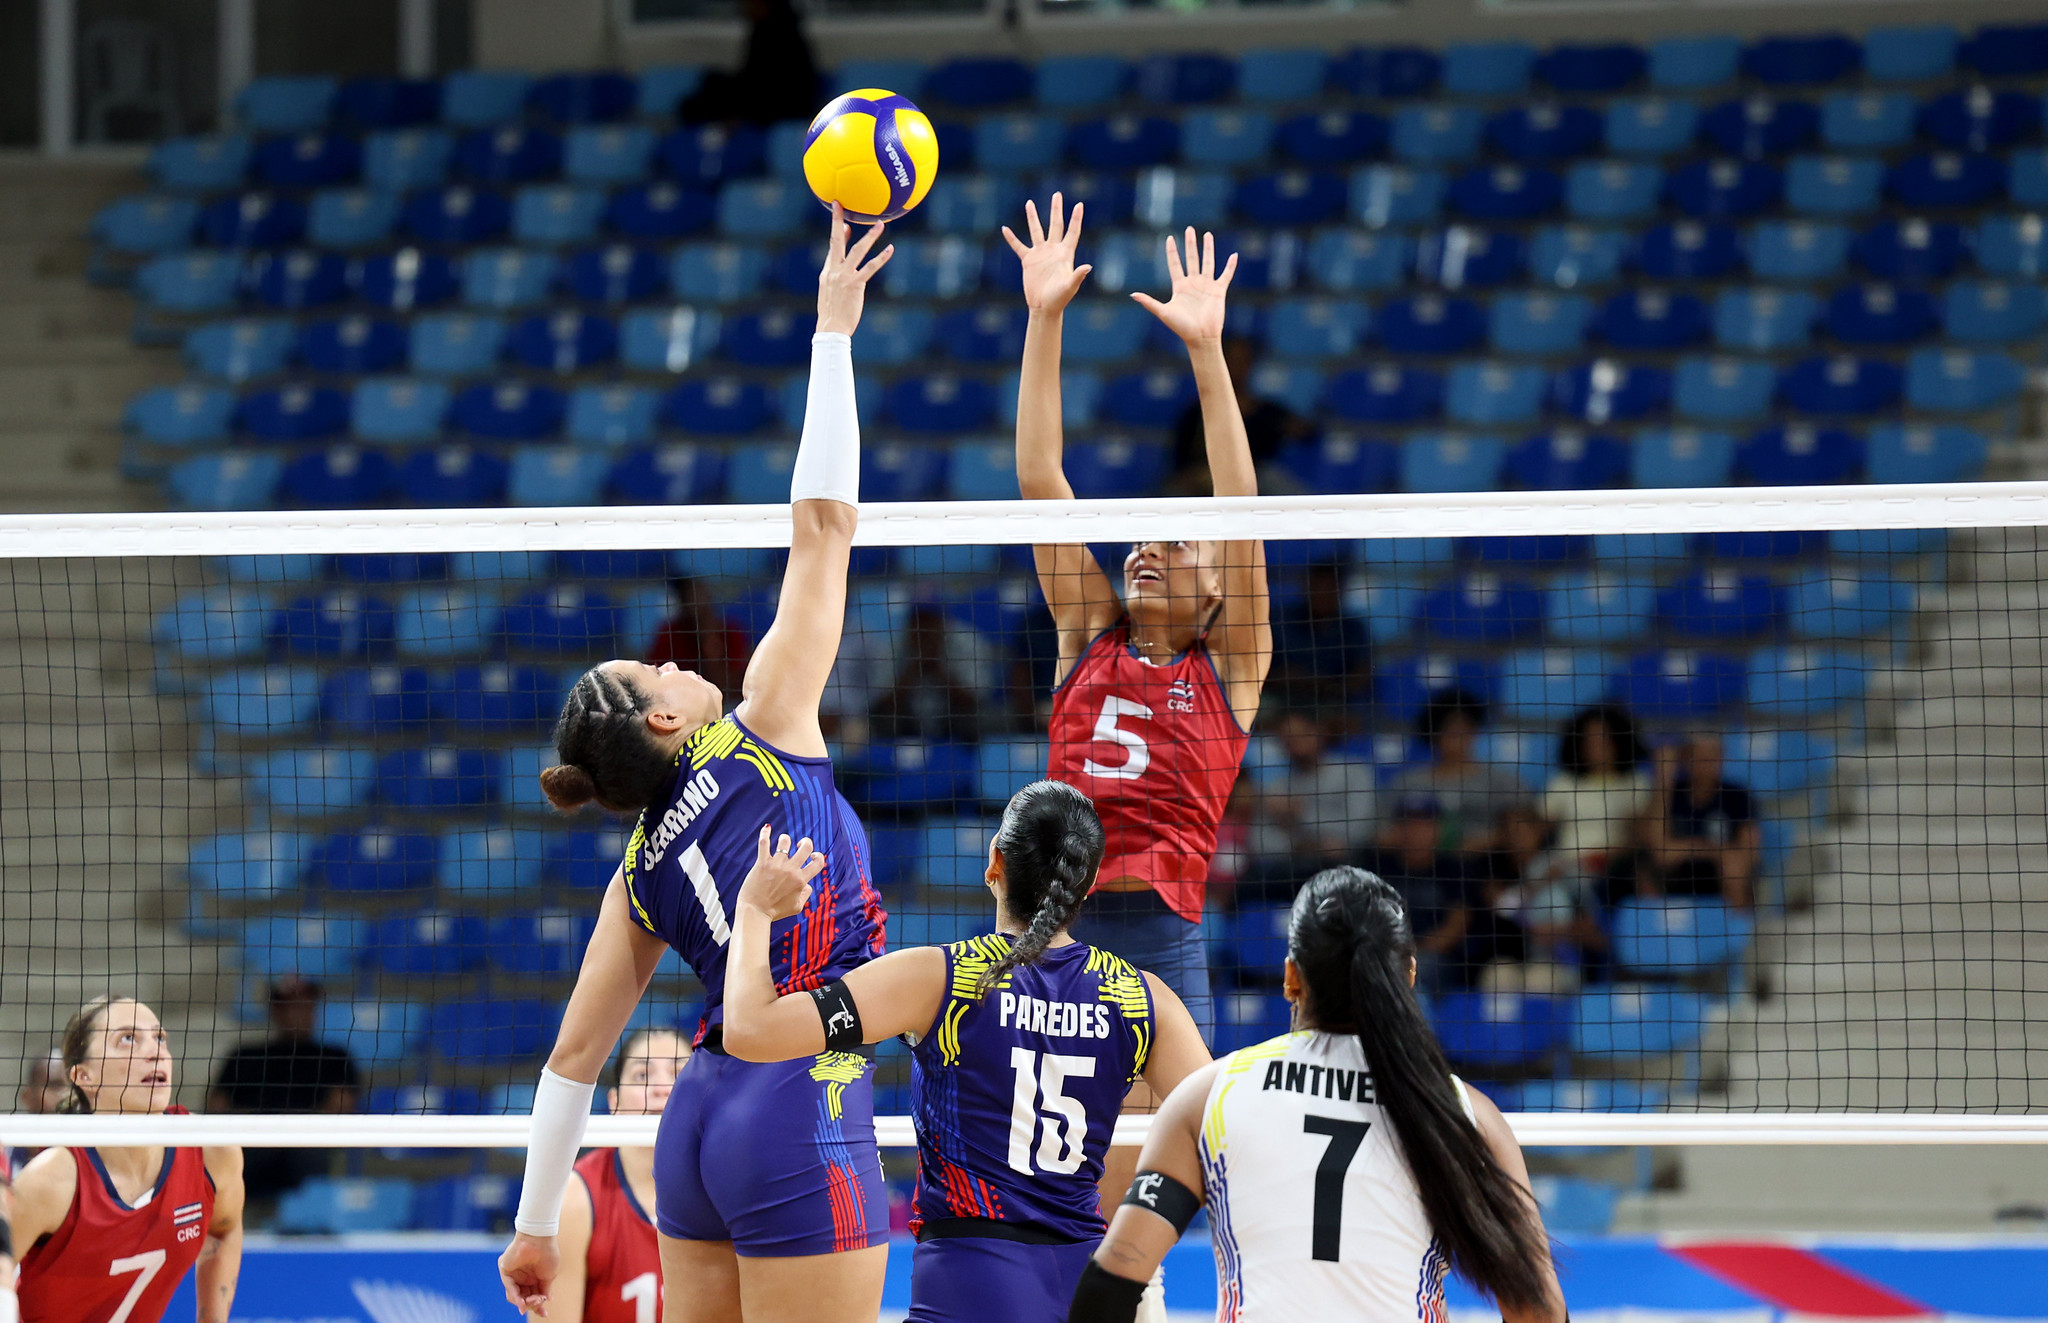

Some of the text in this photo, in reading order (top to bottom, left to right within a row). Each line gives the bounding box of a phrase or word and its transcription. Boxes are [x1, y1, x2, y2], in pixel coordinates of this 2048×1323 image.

[1083, 694, 1154, 780] 5
[1167, 698, 1194, 713] CRC
[644, 769, 720, 871] SERRANO
[678, 838, 732, 947] 1
[1000, 992, 1110, 1039] PAREDES
[1008, 1046, 1097, 1176] 15
[1262, 1060, 1382, 1105] ANTIVE
[1304, 1114, 1372, 1262] 7
[177, 1224, 201, 1243] CRC
[108, 1248, 167, 1323] 7
[621, 1271, 665, 1323] 1
